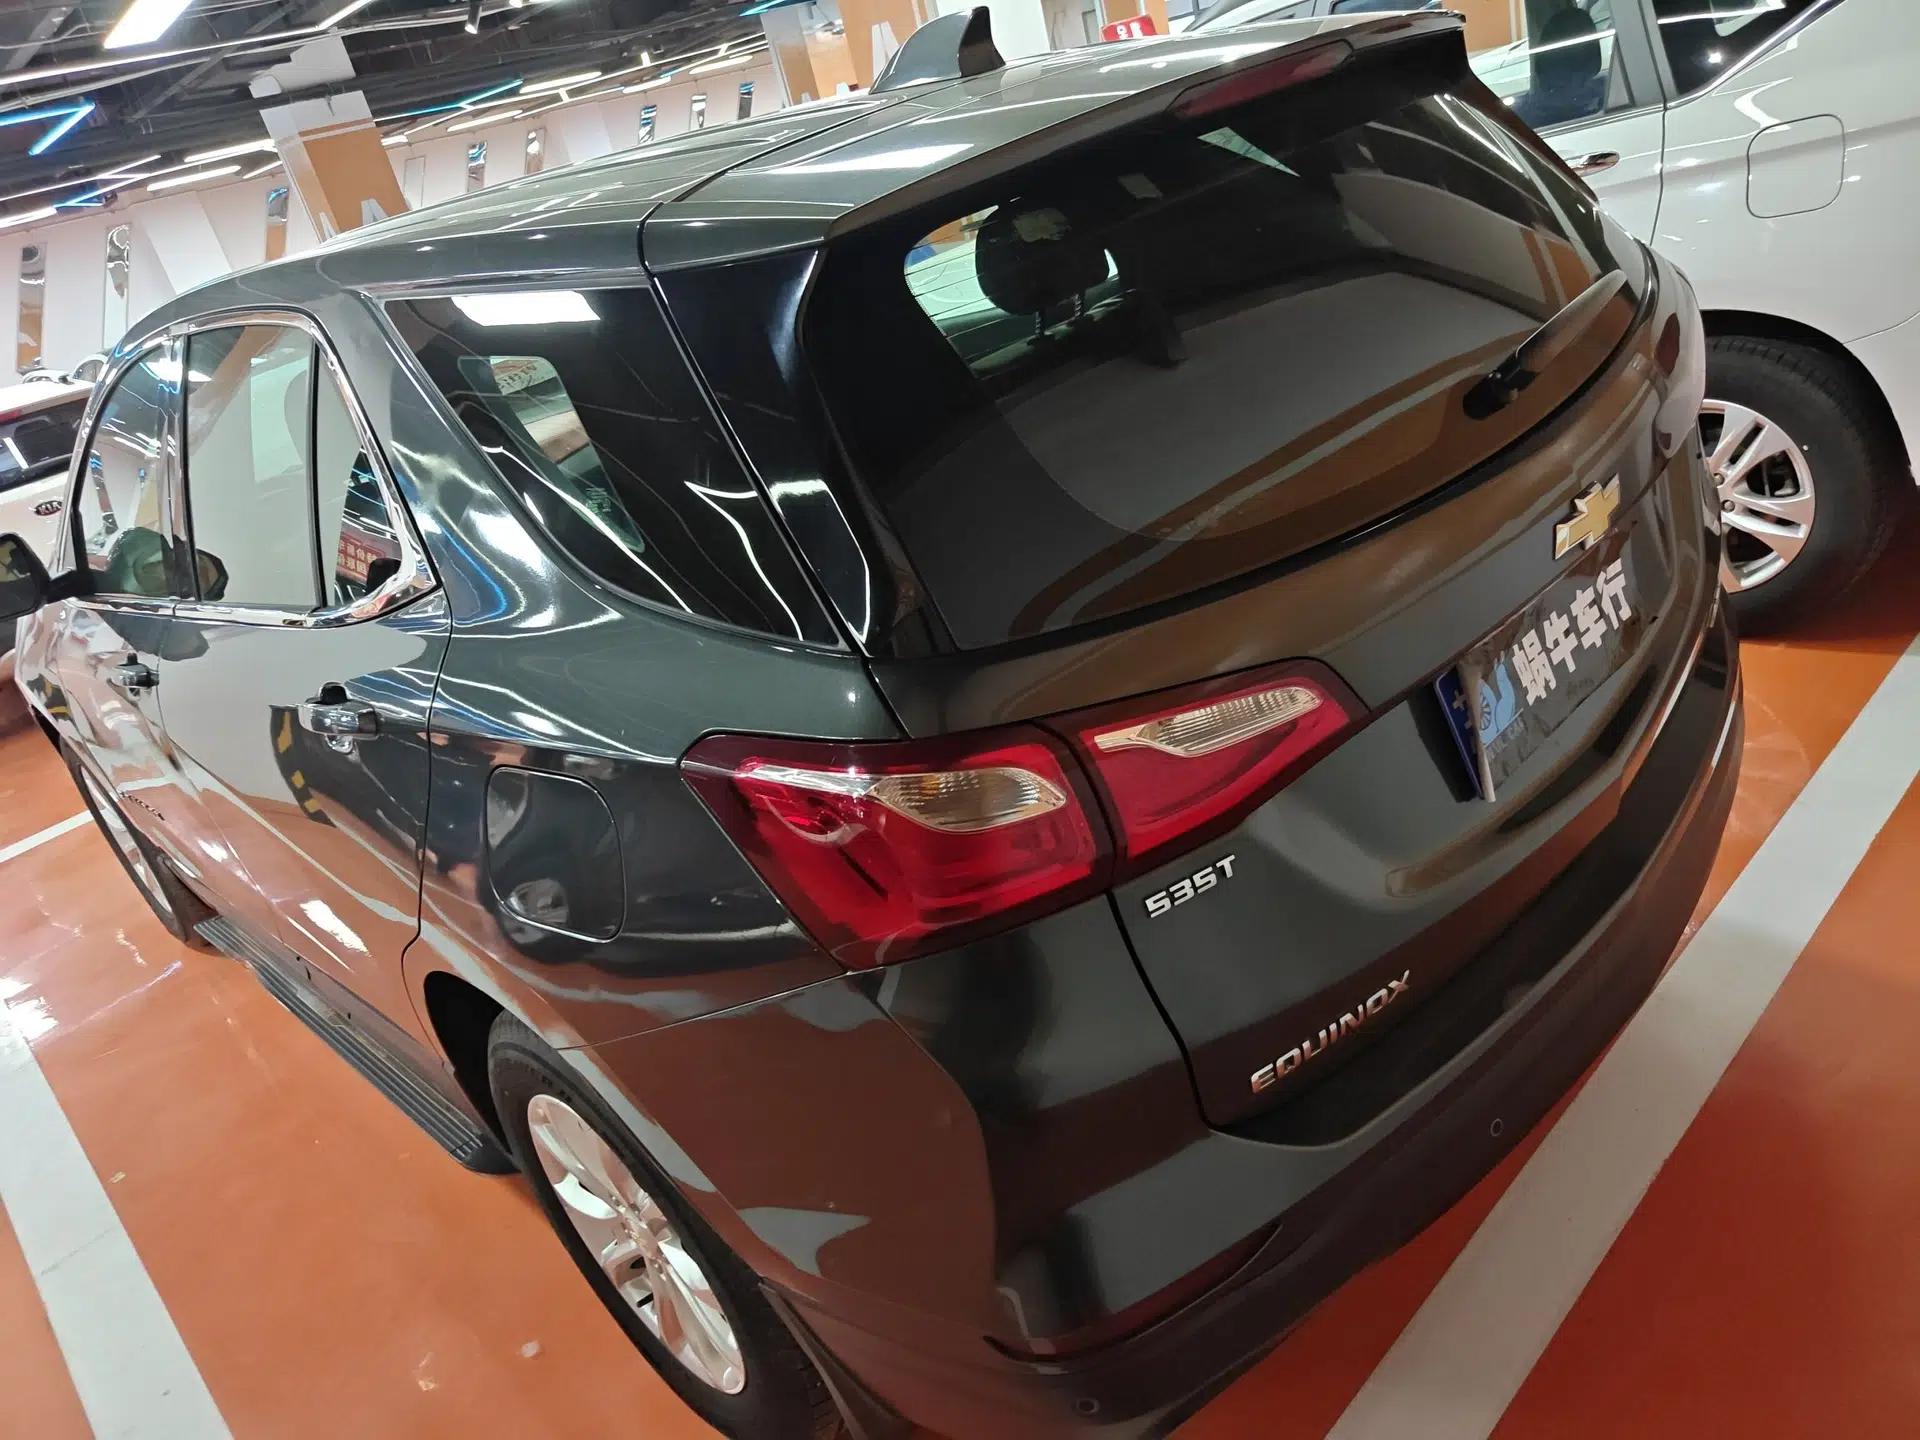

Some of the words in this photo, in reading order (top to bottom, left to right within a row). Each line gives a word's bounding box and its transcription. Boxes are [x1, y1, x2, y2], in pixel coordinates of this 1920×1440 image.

[37, 501, 62, 515] KIA
[1512, 558, 1632, 706] 蜗牛车行
[1145, 854, 1236, 918] 535T
[1250, 969, 1411, 1094] EQUINOX
